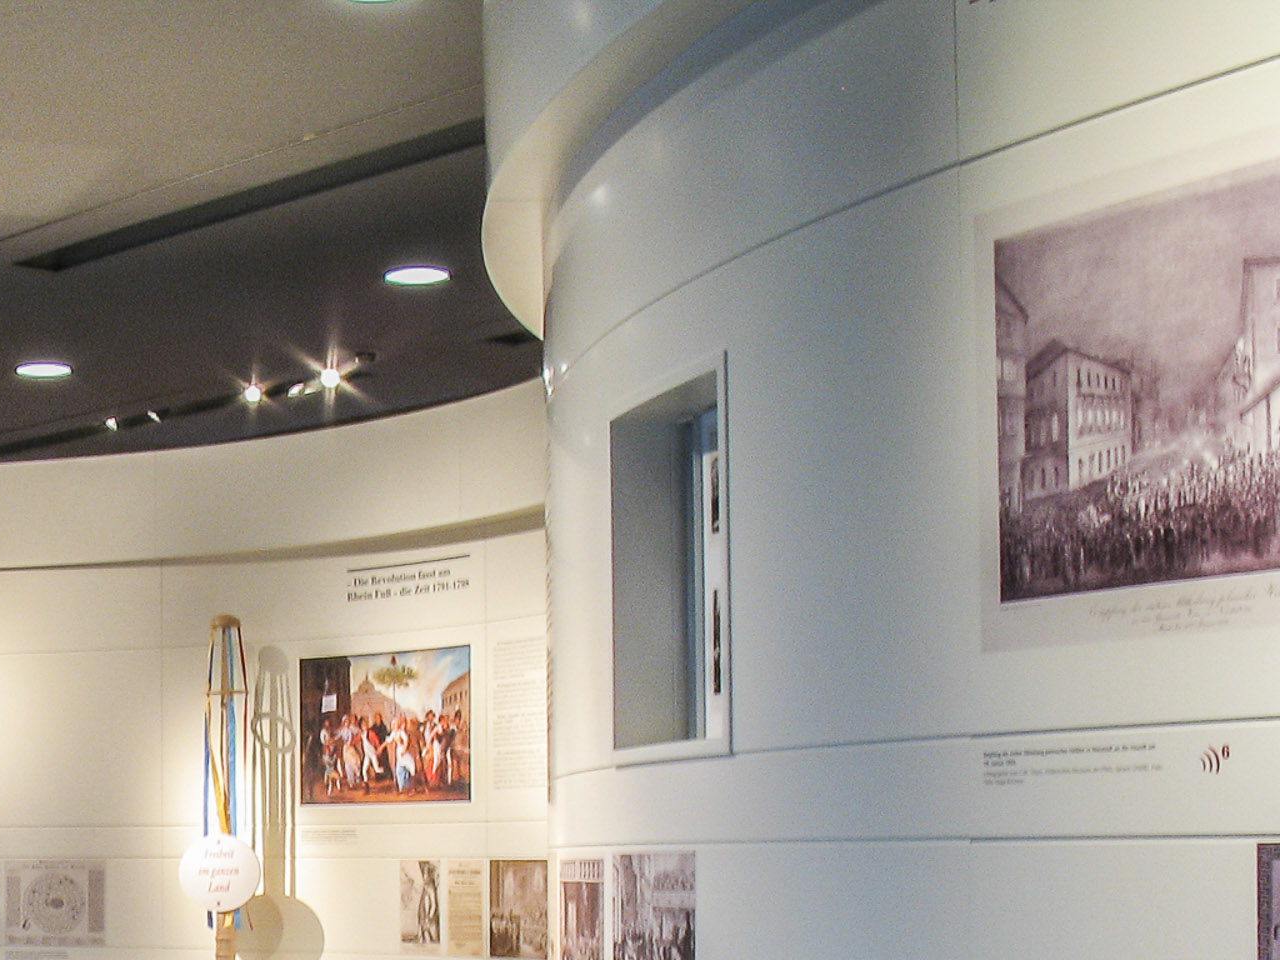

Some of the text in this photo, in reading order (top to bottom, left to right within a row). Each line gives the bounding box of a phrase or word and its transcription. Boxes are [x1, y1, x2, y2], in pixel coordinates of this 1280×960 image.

[371, 573, 417, 586] Revolution
[1221, 744, 1230, 761] 6
[208, 879, 232, 893] Land
